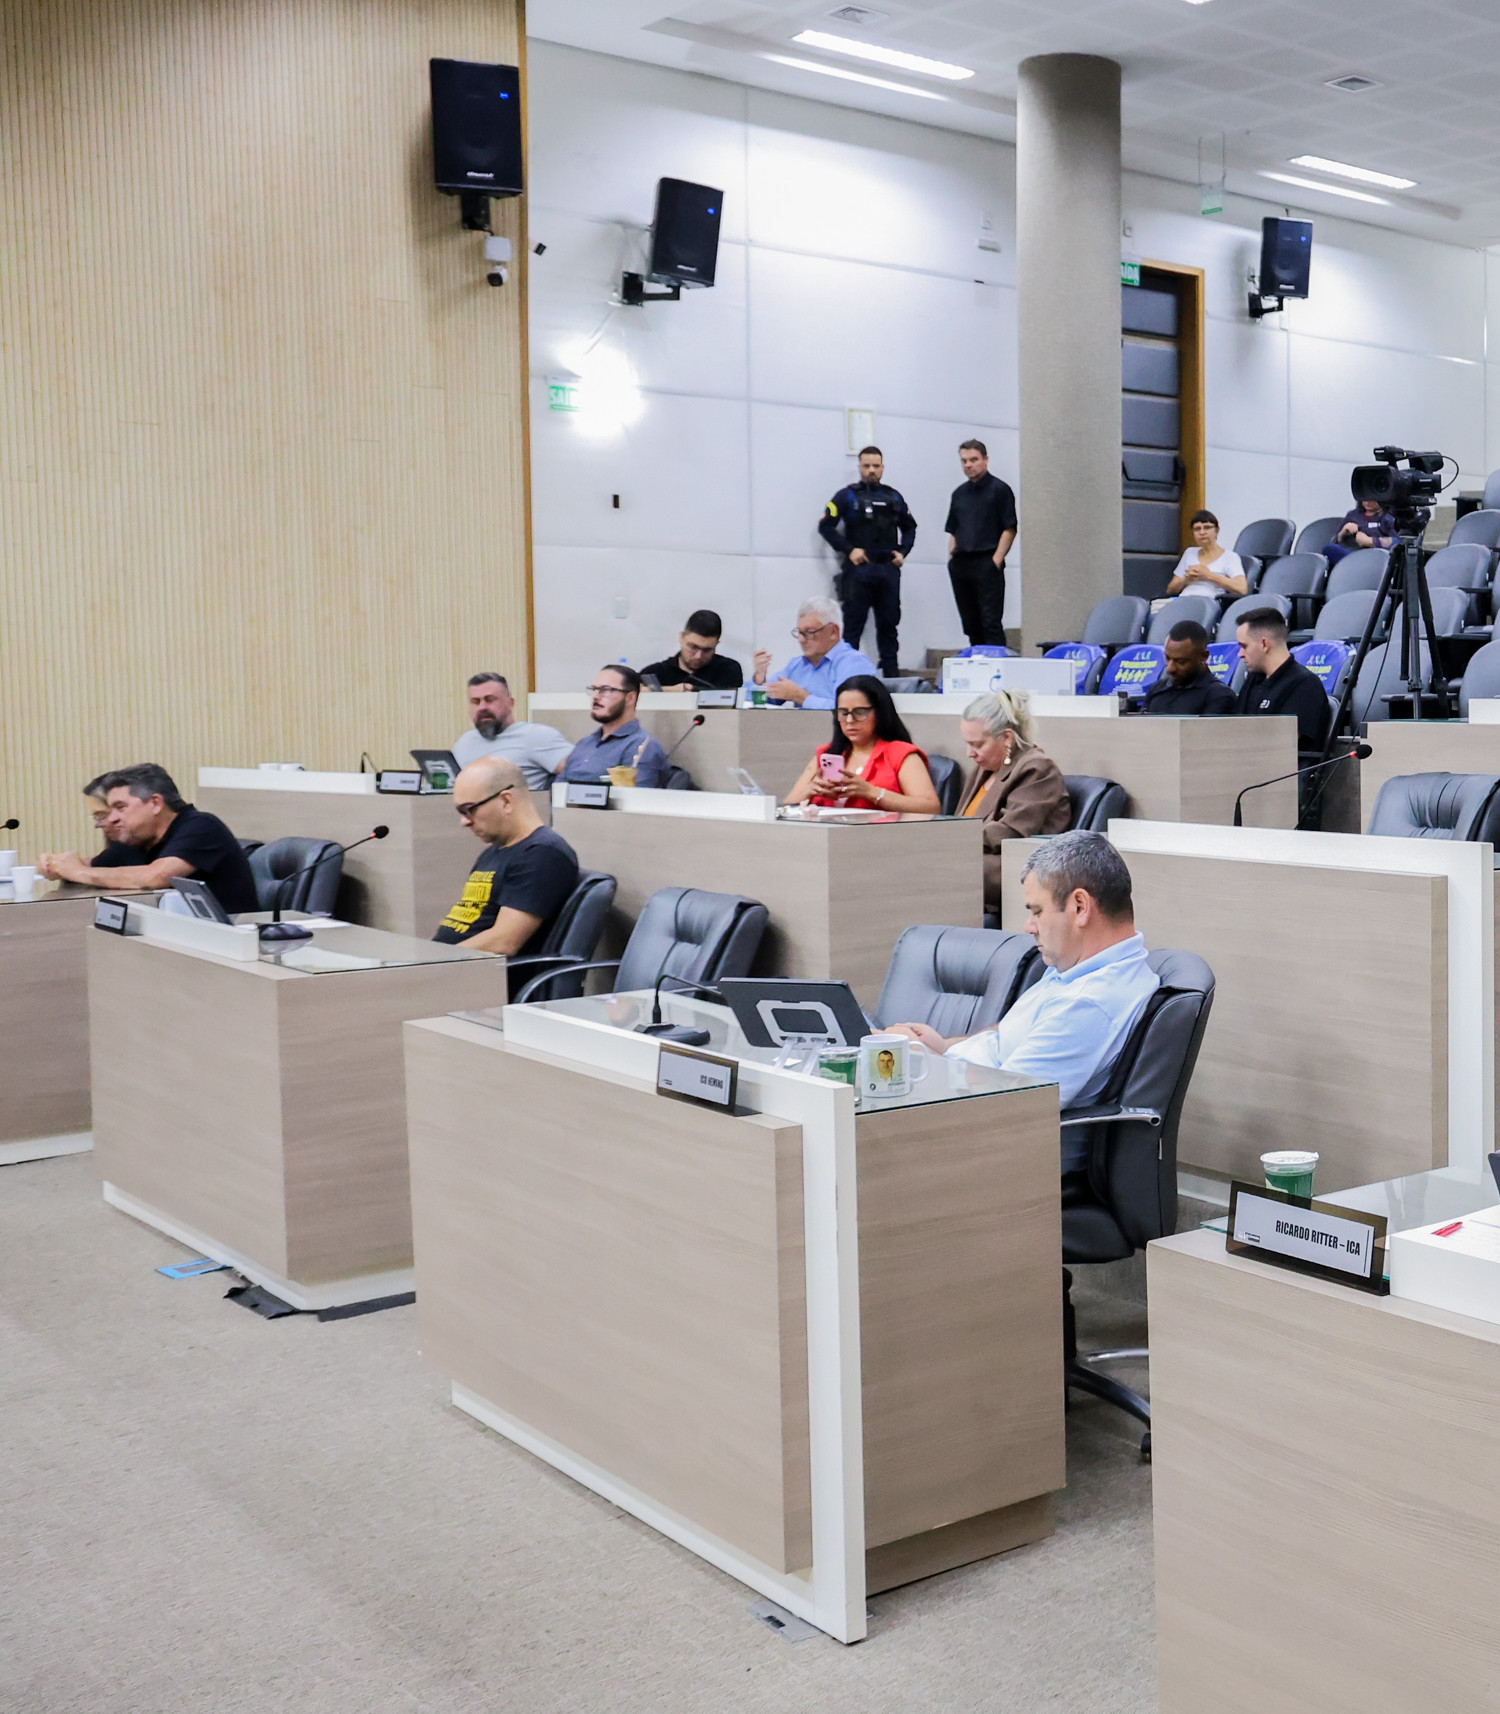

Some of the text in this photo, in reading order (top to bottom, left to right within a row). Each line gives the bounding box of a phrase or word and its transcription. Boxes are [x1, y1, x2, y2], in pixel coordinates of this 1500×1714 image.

[1275, 1220, 1310, 1241] RICARDO
[1311, 1229, 1339, 1249] RITTER
[1346, 1240, 1360, 1256] ICA
